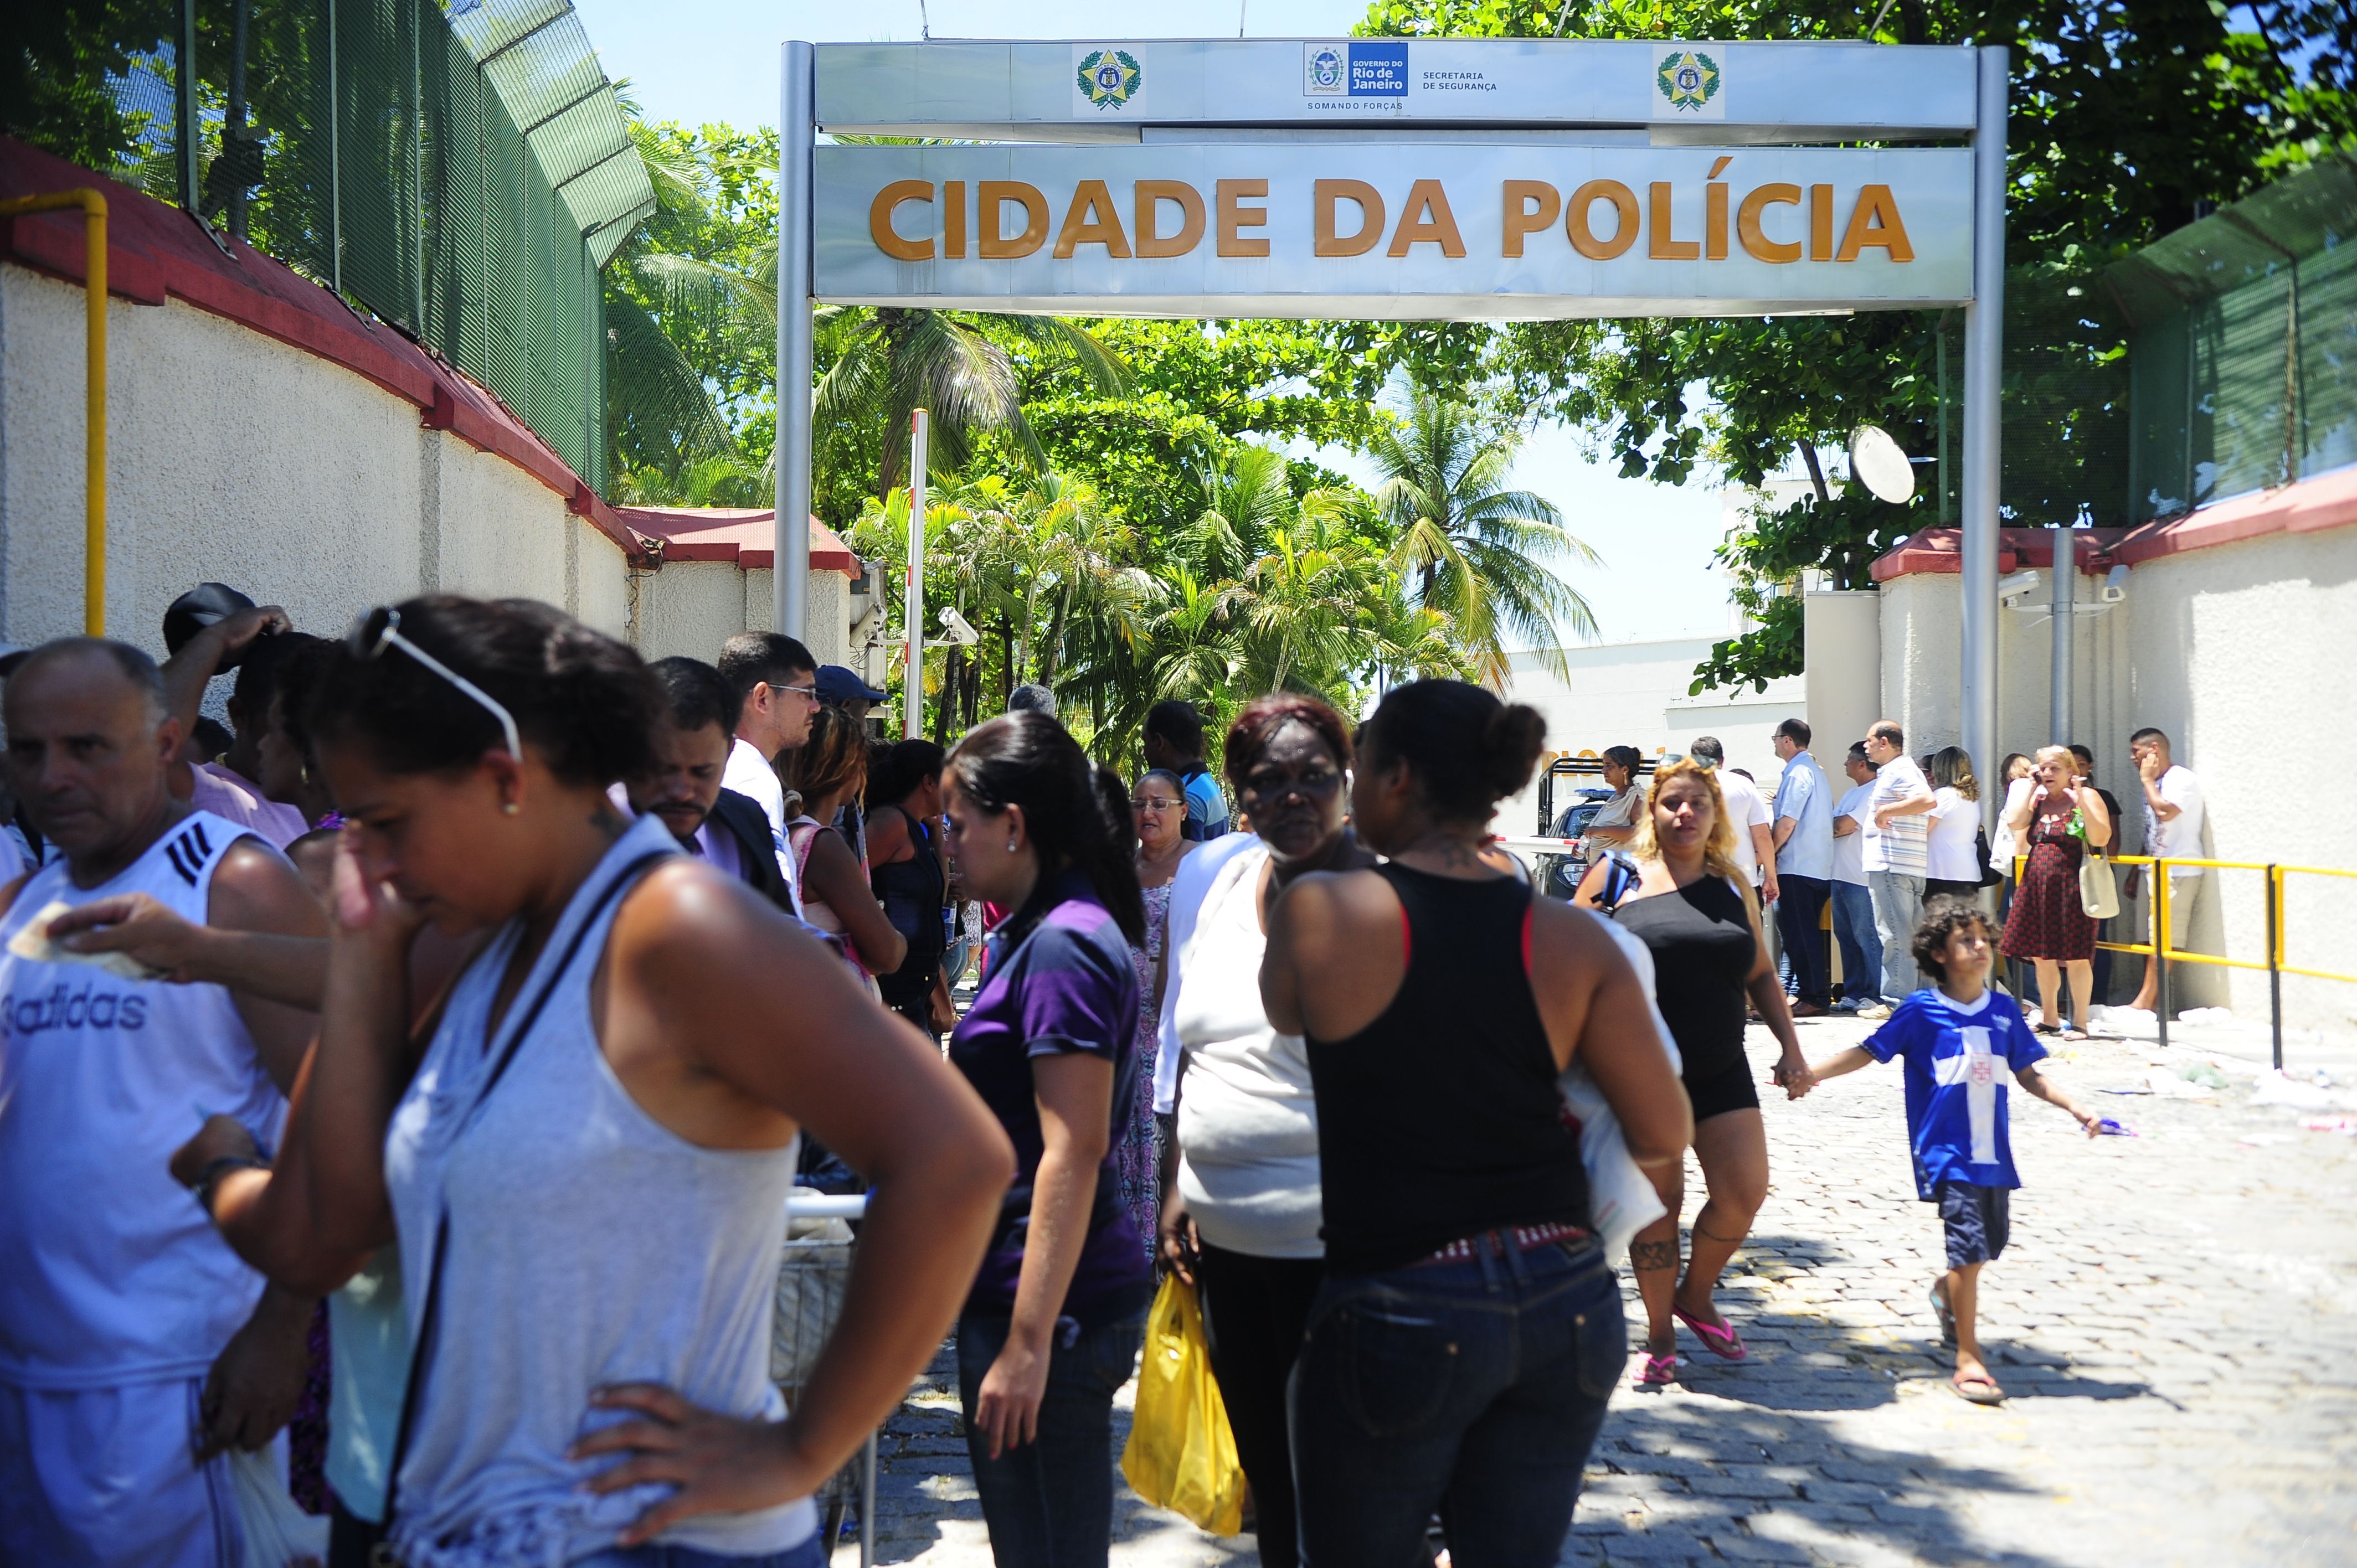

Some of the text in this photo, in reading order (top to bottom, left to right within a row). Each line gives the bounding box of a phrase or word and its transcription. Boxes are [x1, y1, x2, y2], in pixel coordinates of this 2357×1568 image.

[1353, 68, 1393, 78] Rio de
[1353, 79, 1403, 89] Janeiro
[1438, 83, 1497, 92] SEGURANÇA
[1363, 102, 1403, 111] FORÇAS
[870, 156, 1915, 264] CIDADE DA POLÍCIA
